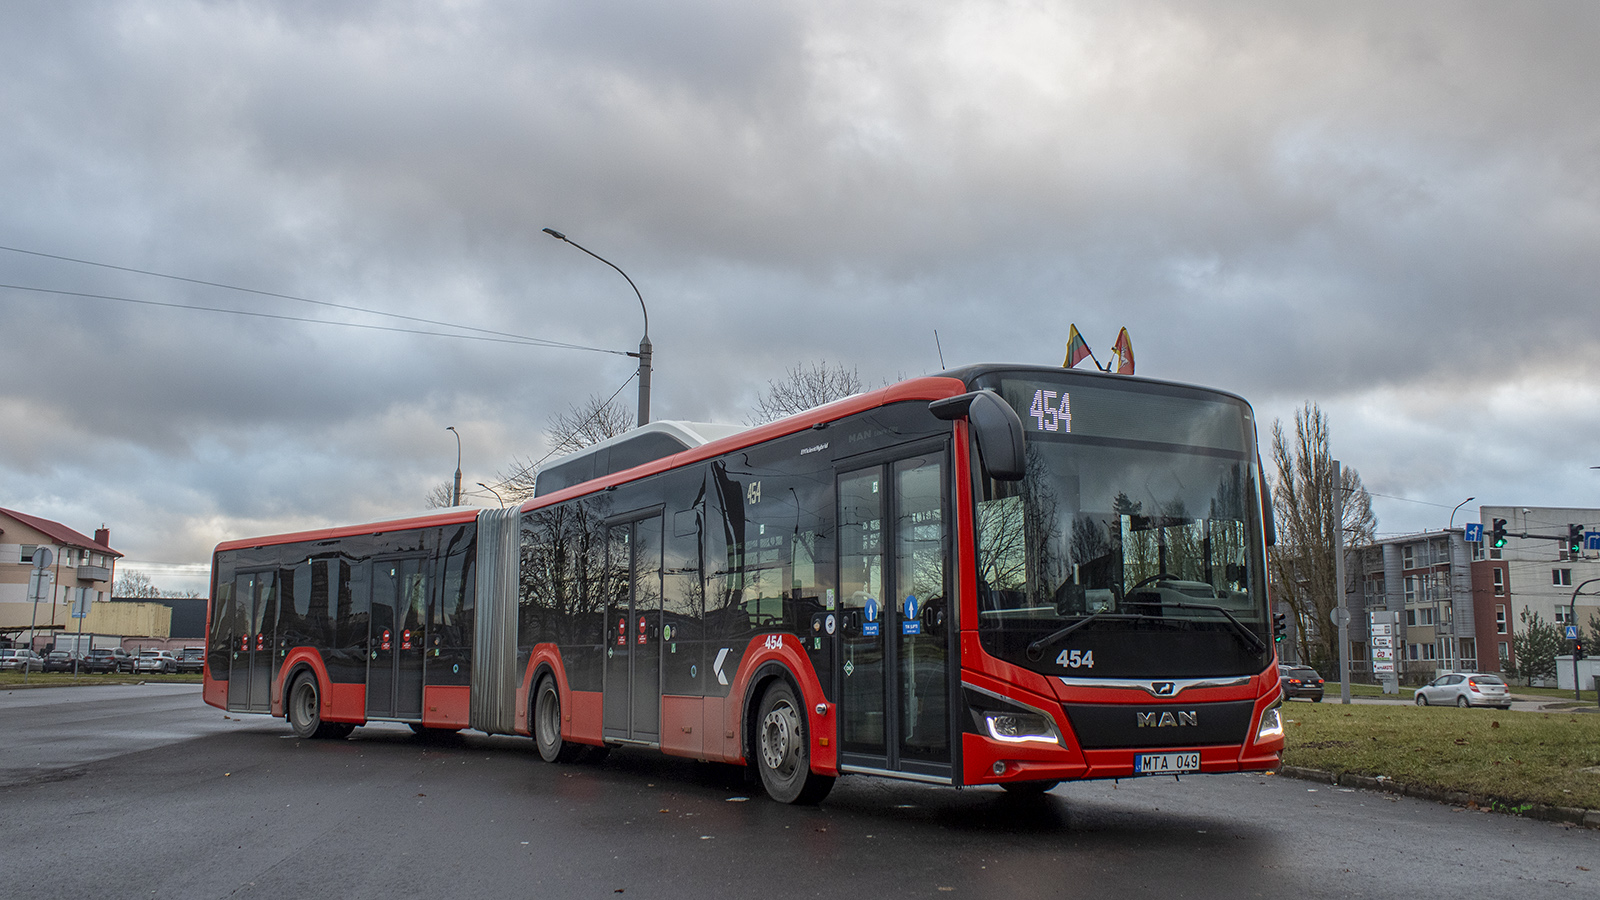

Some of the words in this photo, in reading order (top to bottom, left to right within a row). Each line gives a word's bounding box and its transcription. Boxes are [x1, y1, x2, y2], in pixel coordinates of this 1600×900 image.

[1030, 389, 1072, 433] 454
[848, 429, 872, 443] MAN
[747, 480, 761, 505] 454
[765, 635, 783, 649] 454
[1055, 649, 1095, 668] 454
[1136, 711, 1198, 728] MAN
[1143, 756, 1168, 770] MTA
[1176, 754, 1198, 769] 049
